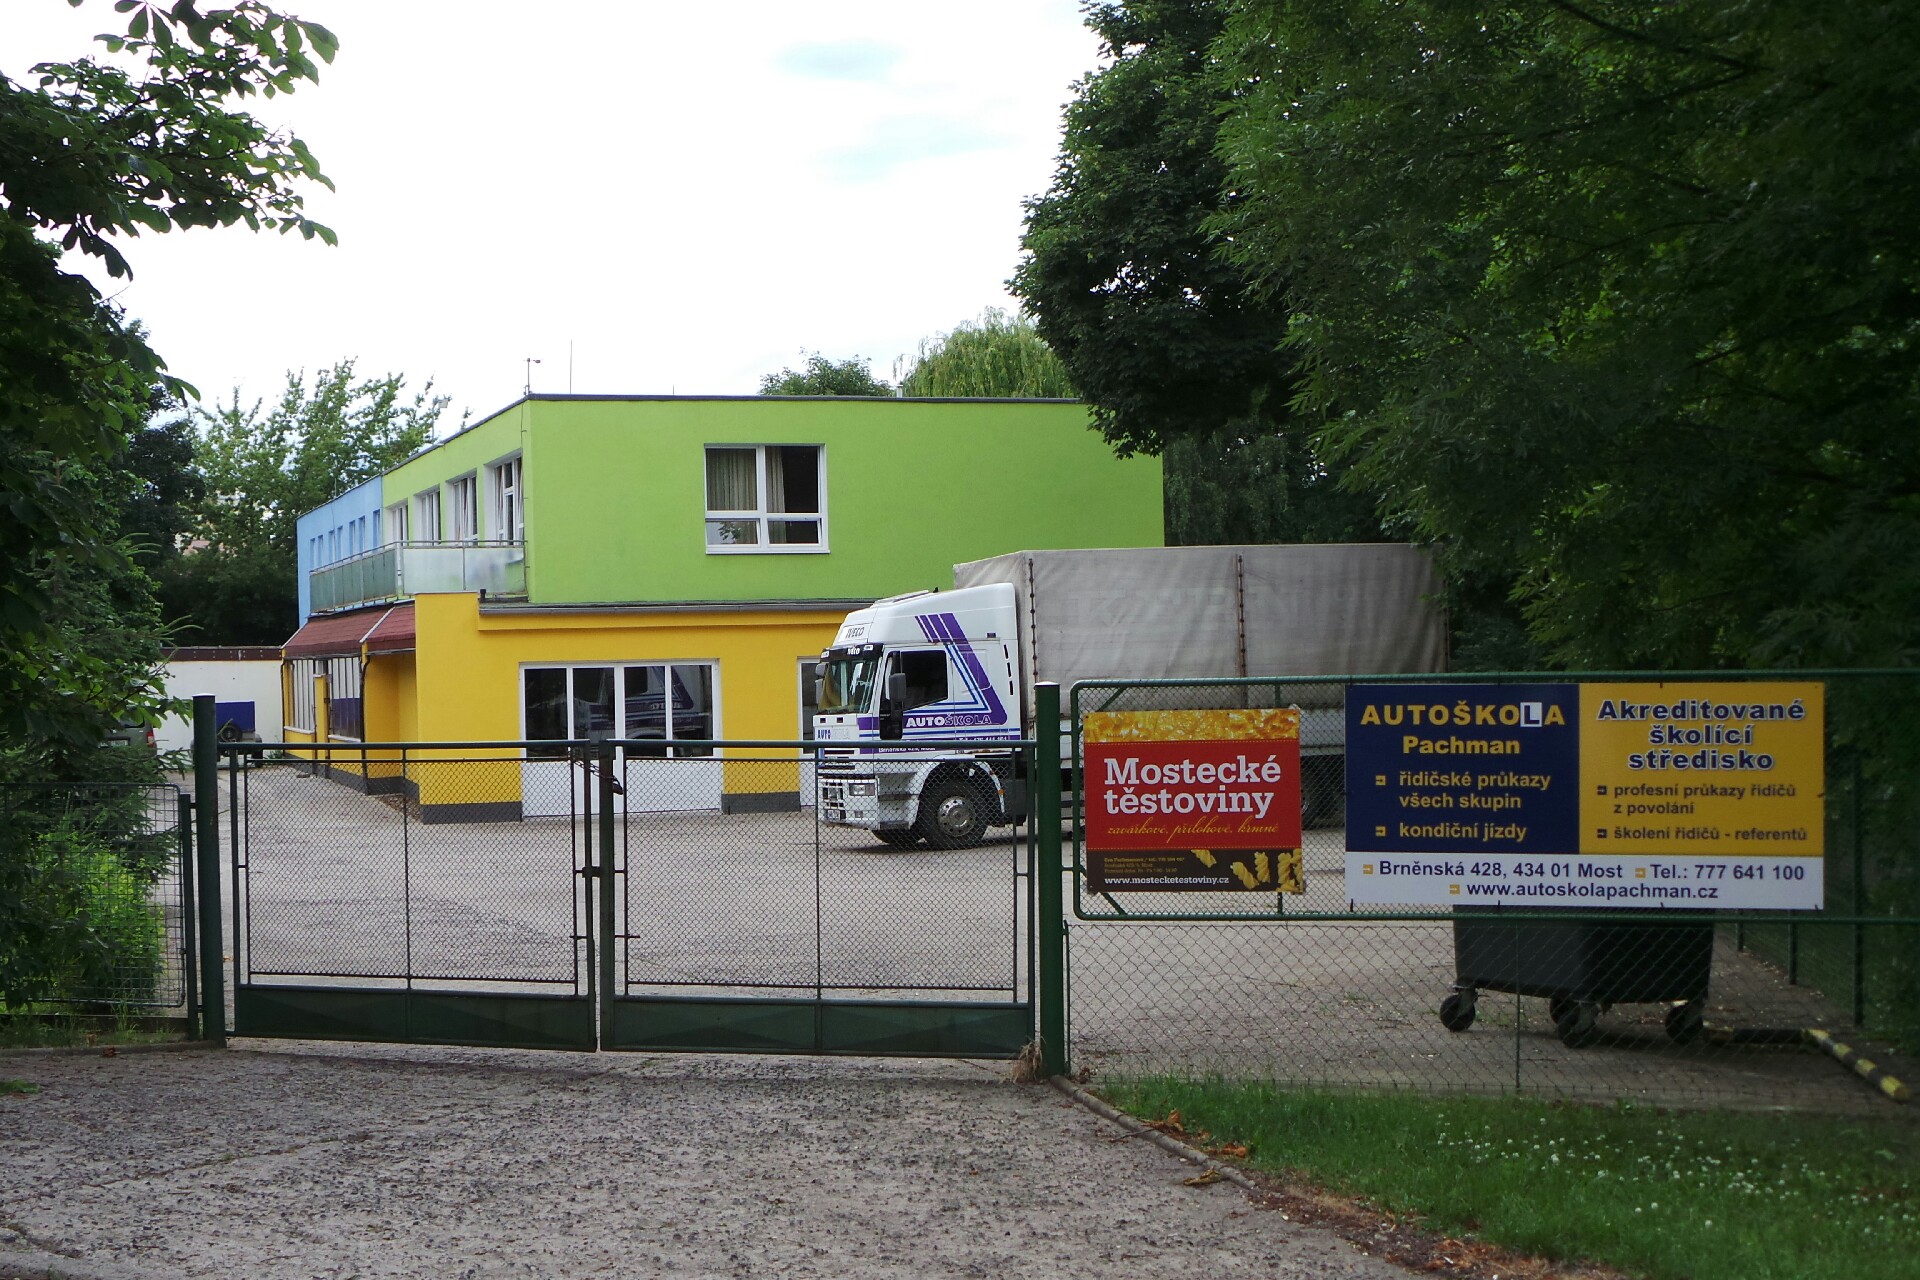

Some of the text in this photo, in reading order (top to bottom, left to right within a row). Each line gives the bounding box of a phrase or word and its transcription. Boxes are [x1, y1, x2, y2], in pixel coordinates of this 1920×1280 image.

[1360, 700, 1565, 727] AUTOŠKOLA
[1597, 698, 1805, 721] Akreditované
[905, 713, 992, 728] AUTOŠKOLA
[1648, 724, 1754, 745] školící
[1403, 736, 1521, 754] Pachman
[1628, 749, 1774, 770] středisko
[1104, 755, 1281, 785] Mostecké
[1399, 771, 1551, 790] řidičské průkazy
[1614, 783, 1796, 799] profesní průkazy řidičů
[1104, 785, 1274, 819] těstoviny
[1399, 793, 1521, 811] všech skupin
[1613, 802, 1694, 816] z povolání
[1399, 822, 1527, 842] kondiční jízdy
[1614, 827, 1670, 840] školení
[1675, 827, 1720, 840] řidičů
[1735, 828, 1807, 841] referentů
[1379, 861, 1804, 880] Brněnská 428, 434 01 Most Tel.: 777 641 100
[1104, 875, 1229, 886] www.mostecketestoviny.cz
[1467, 882, 1718, 900] www.autoskolapachman.cz
